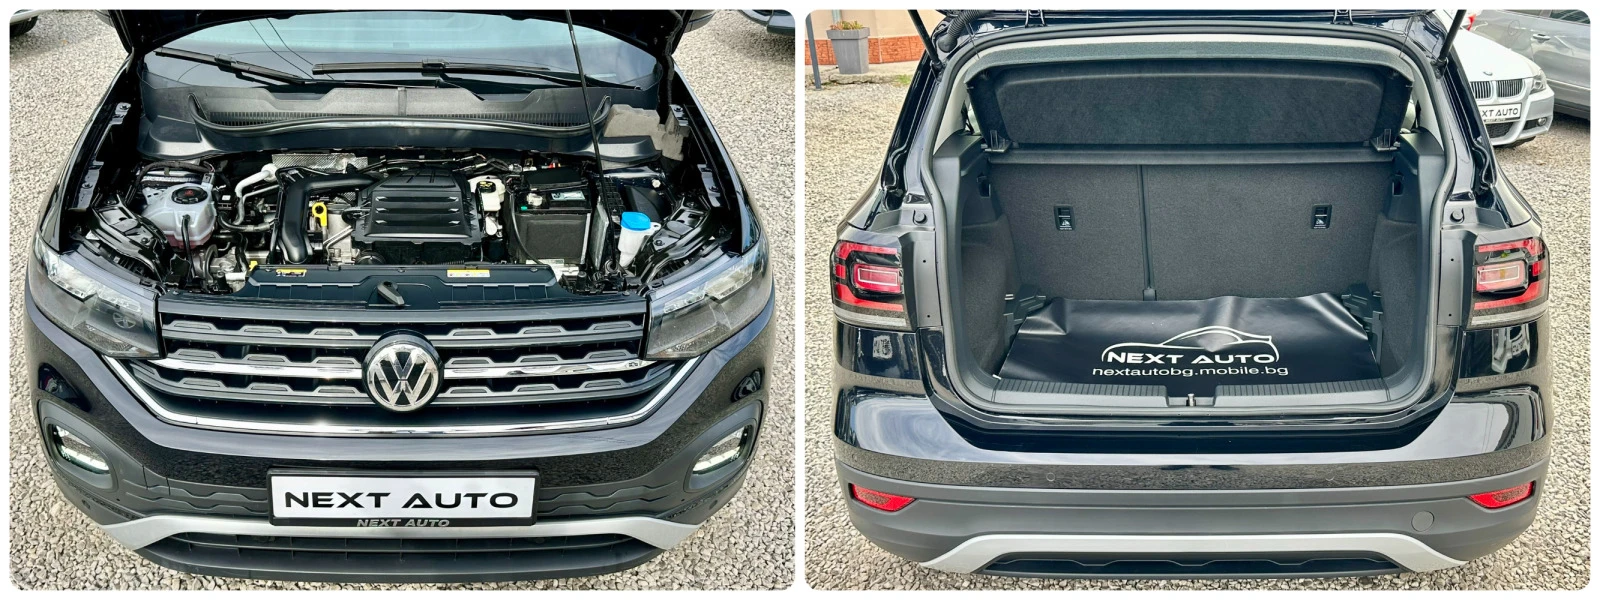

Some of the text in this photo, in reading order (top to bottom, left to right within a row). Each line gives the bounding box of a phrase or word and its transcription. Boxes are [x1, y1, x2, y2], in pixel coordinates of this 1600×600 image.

[1495, 108, 1519, 117] AUTO
[1107, 351, 1275, 364] NEXT AUTO
[1092, 366, 1289, 377] nextautobg.mobile.bg
[285, 491, 519, 509] NEXT AUTO
[356, 519, 450, 527] NEXT AUTO
